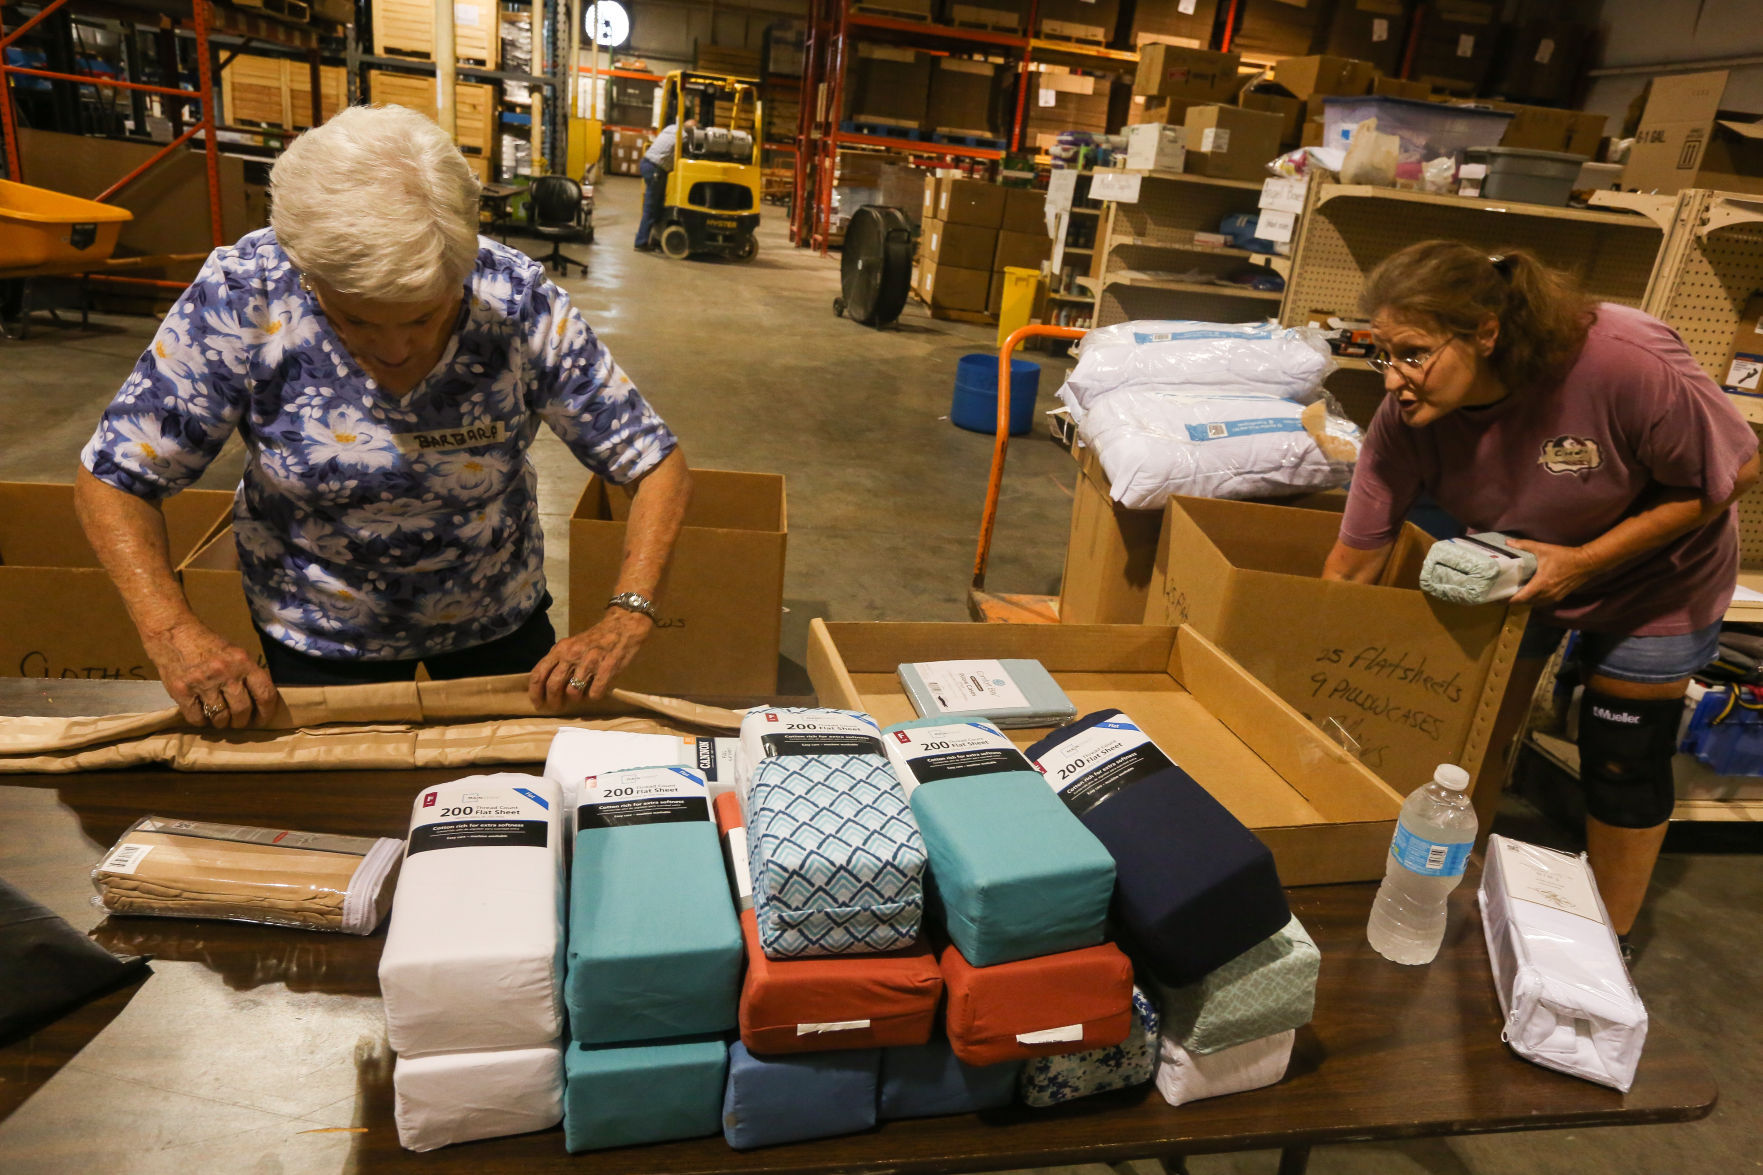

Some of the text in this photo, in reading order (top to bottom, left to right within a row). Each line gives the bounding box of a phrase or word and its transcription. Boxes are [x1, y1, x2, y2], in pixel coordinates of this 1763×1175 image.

[1316, 648, 1344, 664] 25
[1311, 672, 1328, 698] 9
[1328, 678, 1445, 741] PILLOWCASES
[1598, 707, 1641, 724] Mueller
[921, 741, 950, 751] 200
[1086, 753, 1102, 764] Flat
[1101, 742, 1123, 755] Sheet
[699, 741, 711, 769] CANNON
[1057, 758, 1085, 780] 200
[1066, 780, 1085, 794] Cotton
[1102, 762, 1117, 772] extra
[525, 791, 536, 799] Flat
[603, 787, 634, 798] 200
[440, 806, 473, 818] 200
